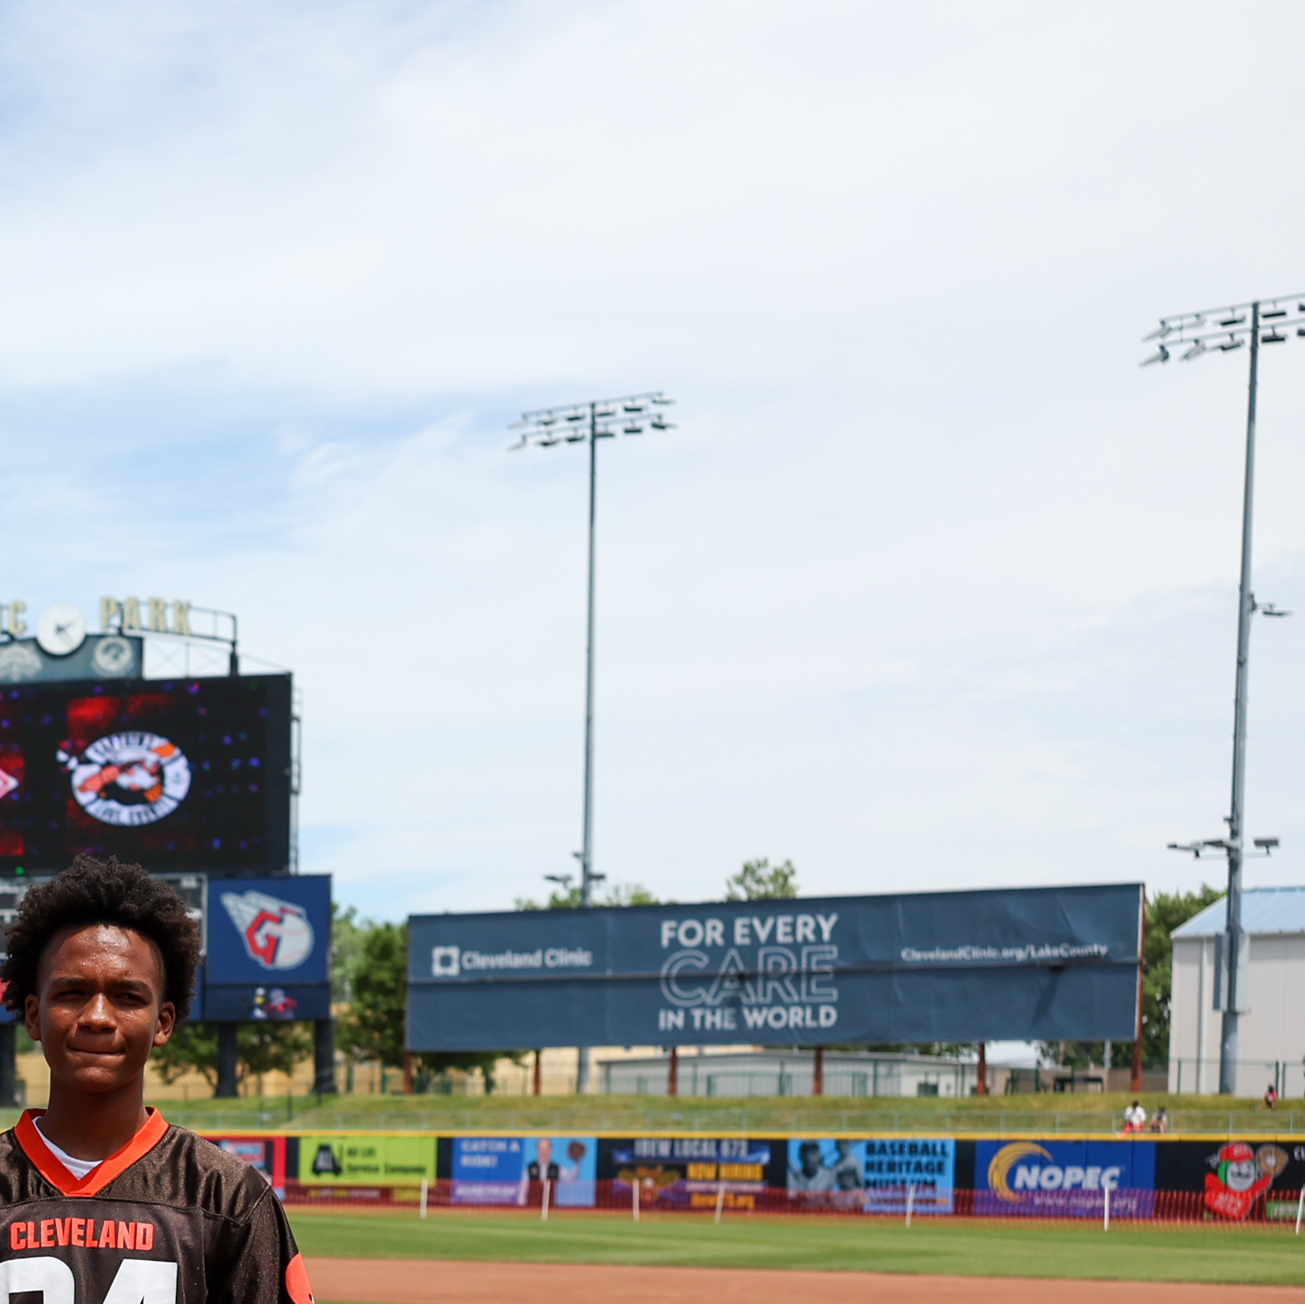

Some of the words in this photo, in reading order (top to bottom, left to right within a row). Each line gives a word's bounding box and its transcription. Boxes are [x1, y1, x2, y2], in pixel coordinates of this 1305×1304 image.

[101, 597, 191, 635] PARK
[661, 919, 724, 949] FOR
[733, 913, 839, 946] EVERY
[462, 949, 543, 970] Cleveland
[544, 947, 592, 968] Clinic
[901, 942, 1109, 962] ClevelandClinic.org/LakeCounty
[660, 944, 839, 1008] CARE
[659, 1009, 685, 1031] IN
[691, 1008, 737, 1030] THE
[743, 1005, 838, 1029] WORLD
[460, 1140, 508, 1153] CATCH
[510, 1140, 521, 1153] A
[866, 1142, 947, 1156] BASEBALL
[865, 1160, 946, 1174] HERITAGE
[1014, 1164, 1121, 1191] NOPEC
[9, 1217, 155, 1251] CLEVELAND
